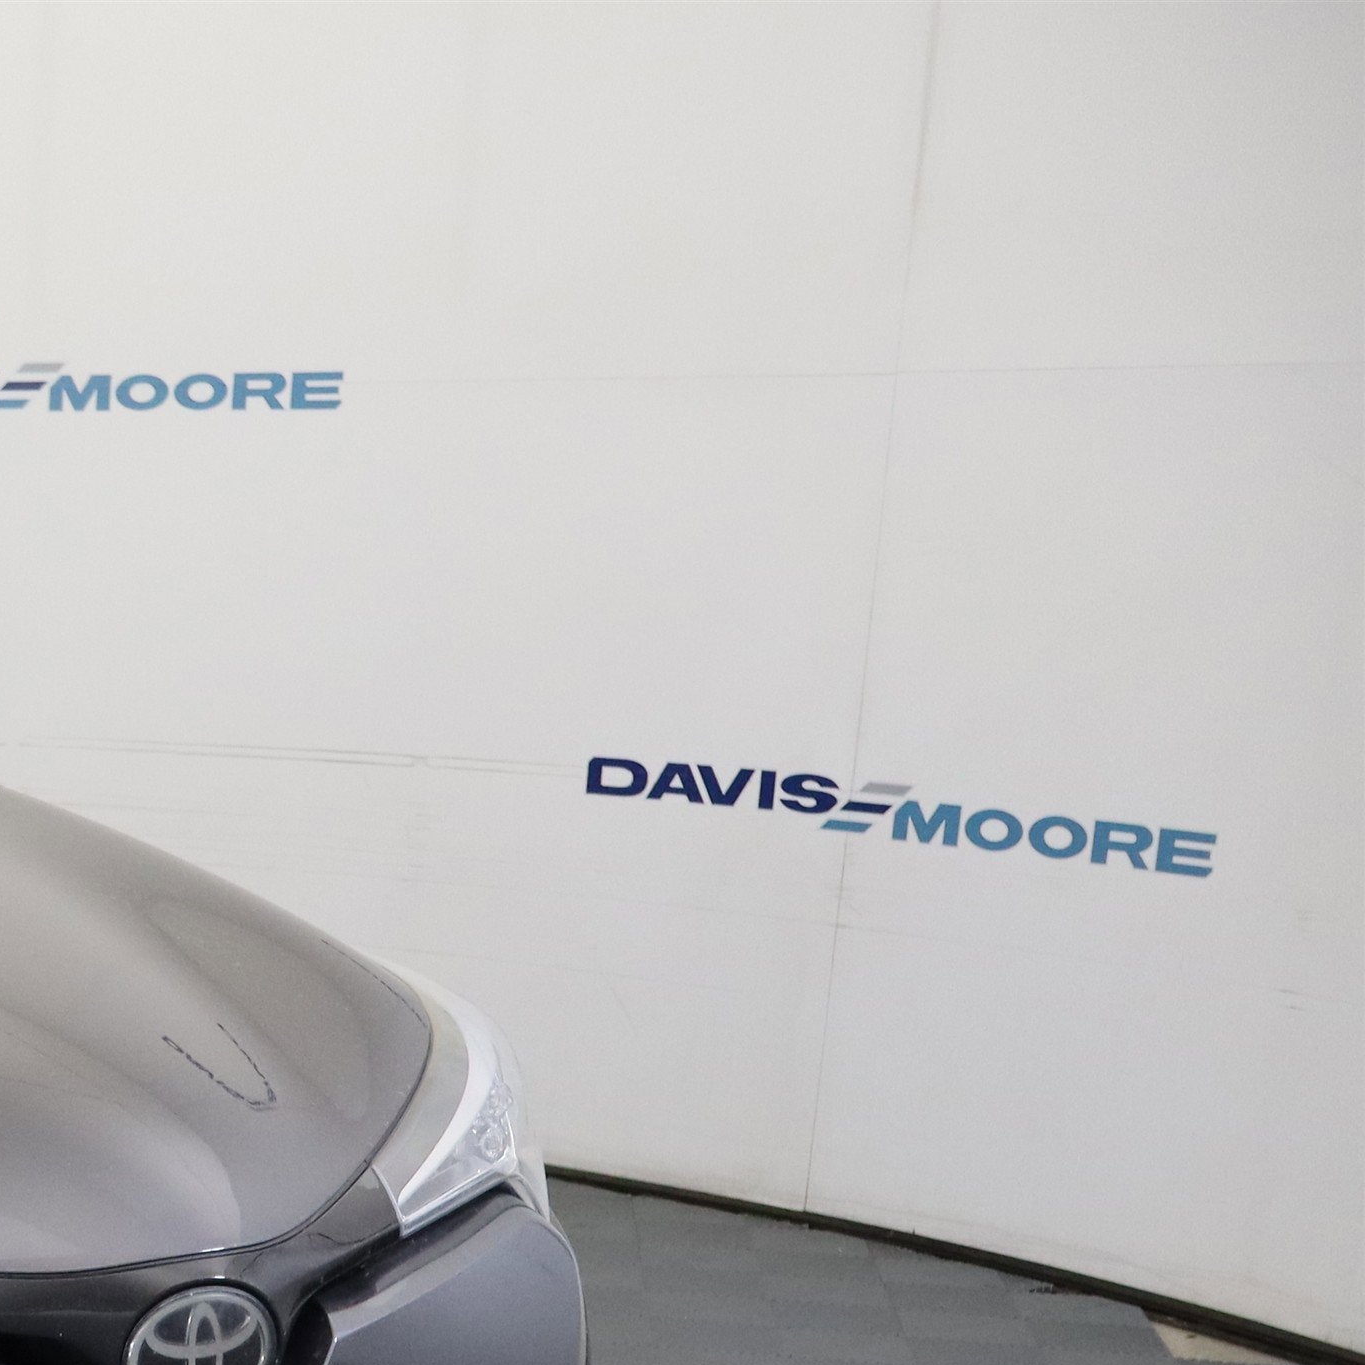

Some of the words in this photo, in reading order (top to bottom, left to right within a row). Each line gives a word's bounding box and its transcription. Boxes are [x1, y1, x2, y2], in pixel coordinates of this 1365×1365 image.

[48, 371, 344, 412] MOORE
[585, 755, 840, 815] DAVIS
[891, 799, 1218, 879] MOORE
